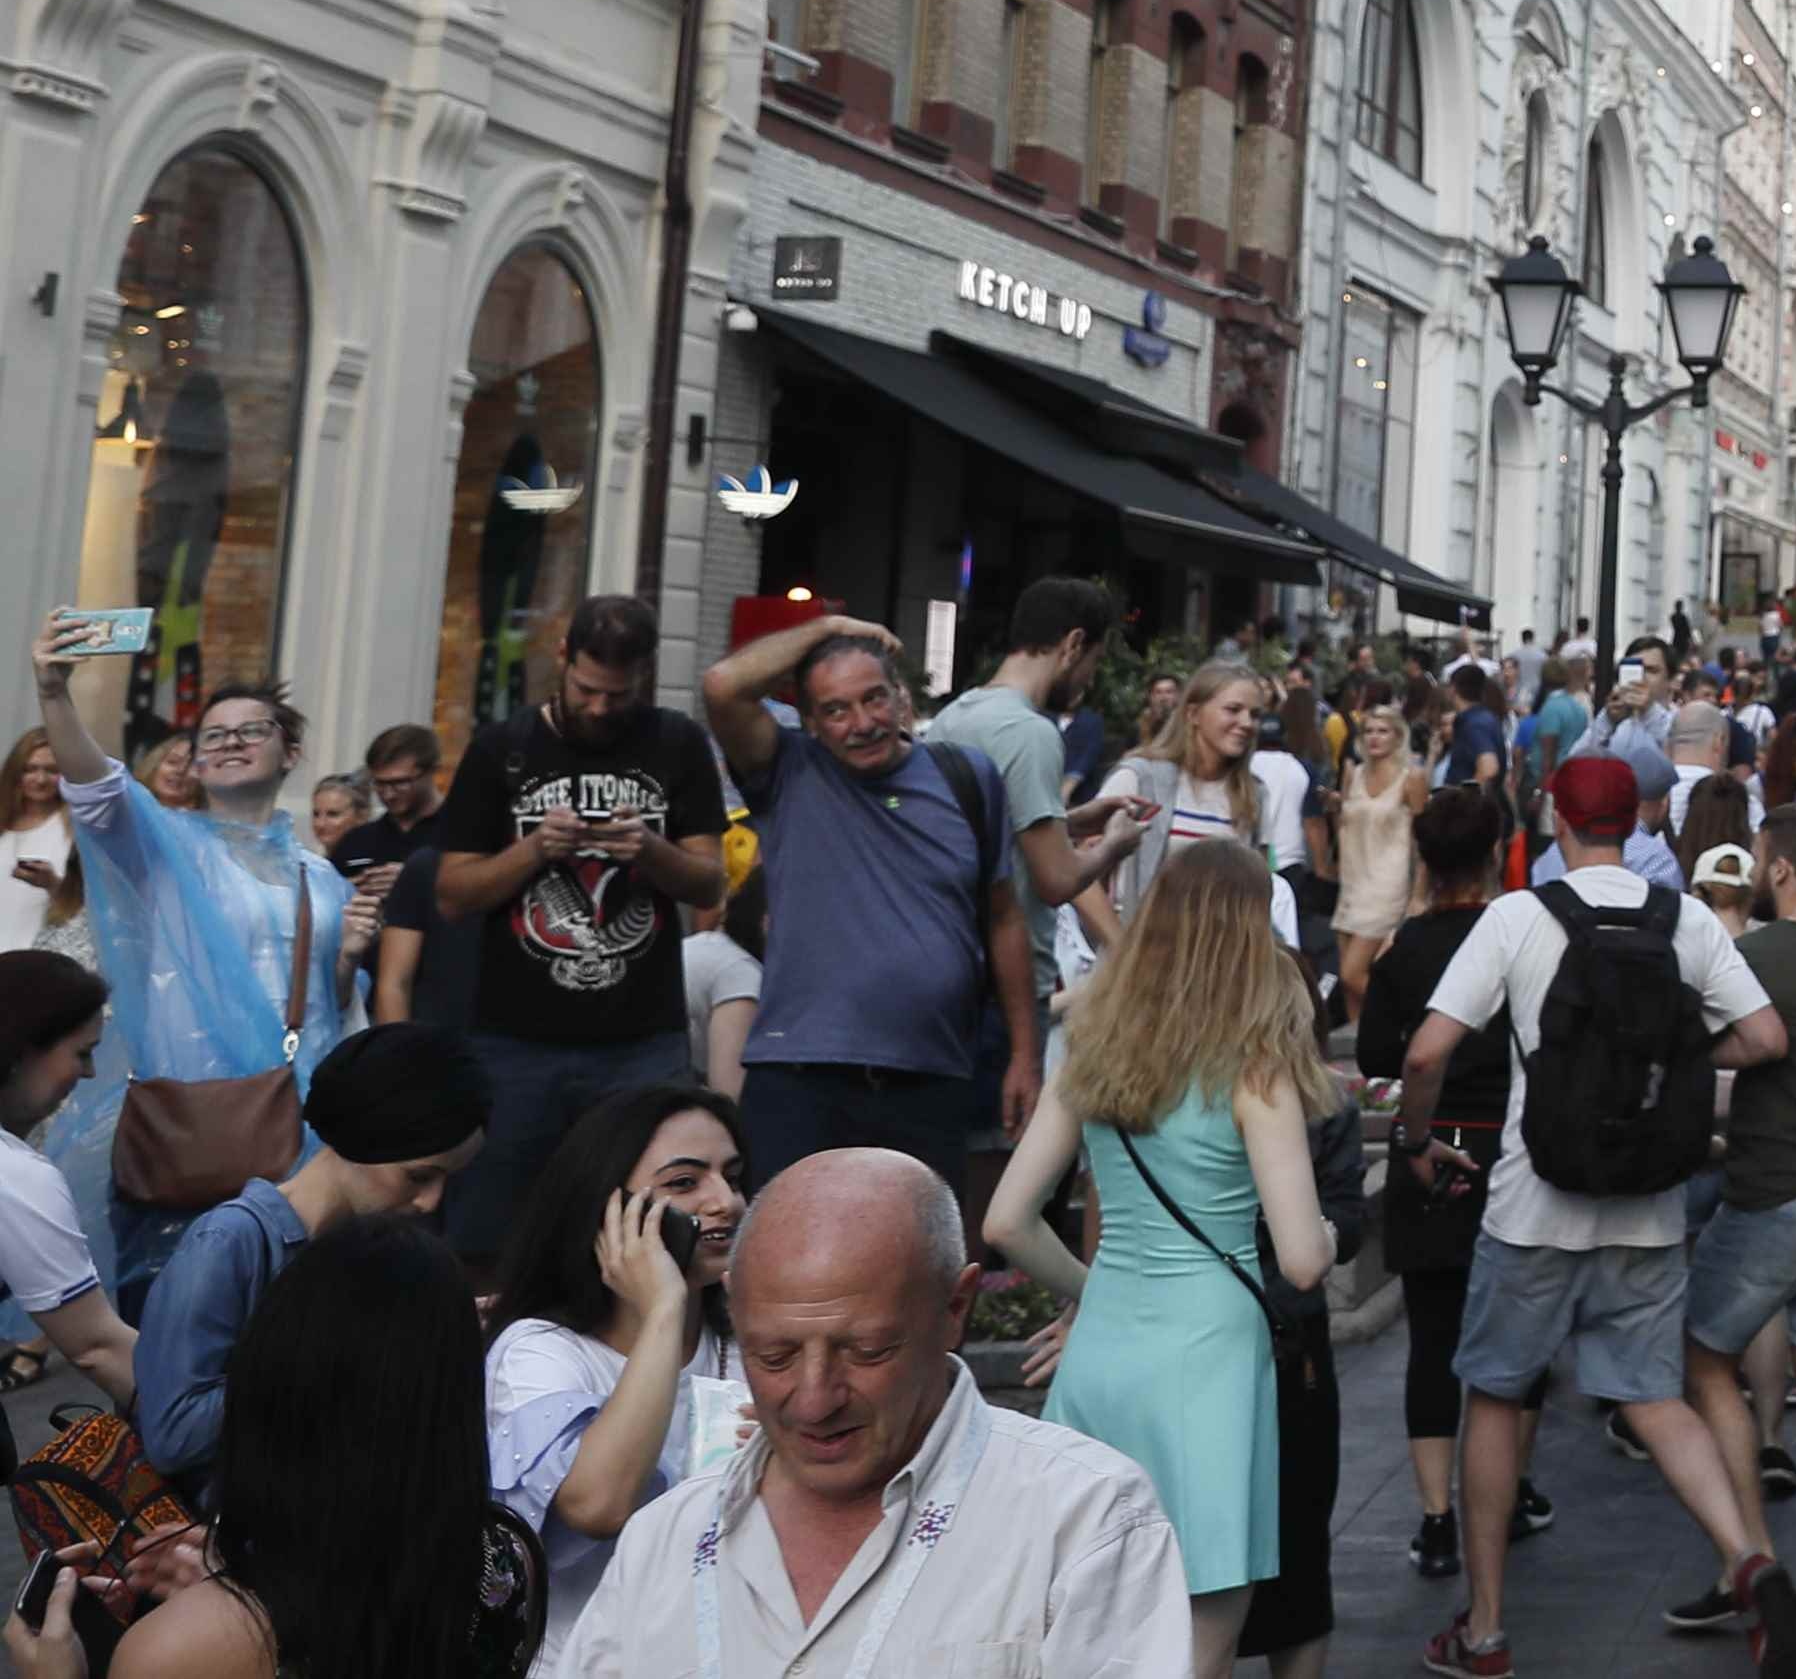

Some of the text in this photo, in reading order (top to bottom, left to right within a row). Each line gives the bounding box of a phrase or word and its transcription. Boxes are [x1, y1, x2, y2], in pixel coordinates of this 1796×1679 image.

[960, 260, 1047, 325] KETCH
[1060, 297, 1092, 339] UP
[534, 777, 572, 811] THE
